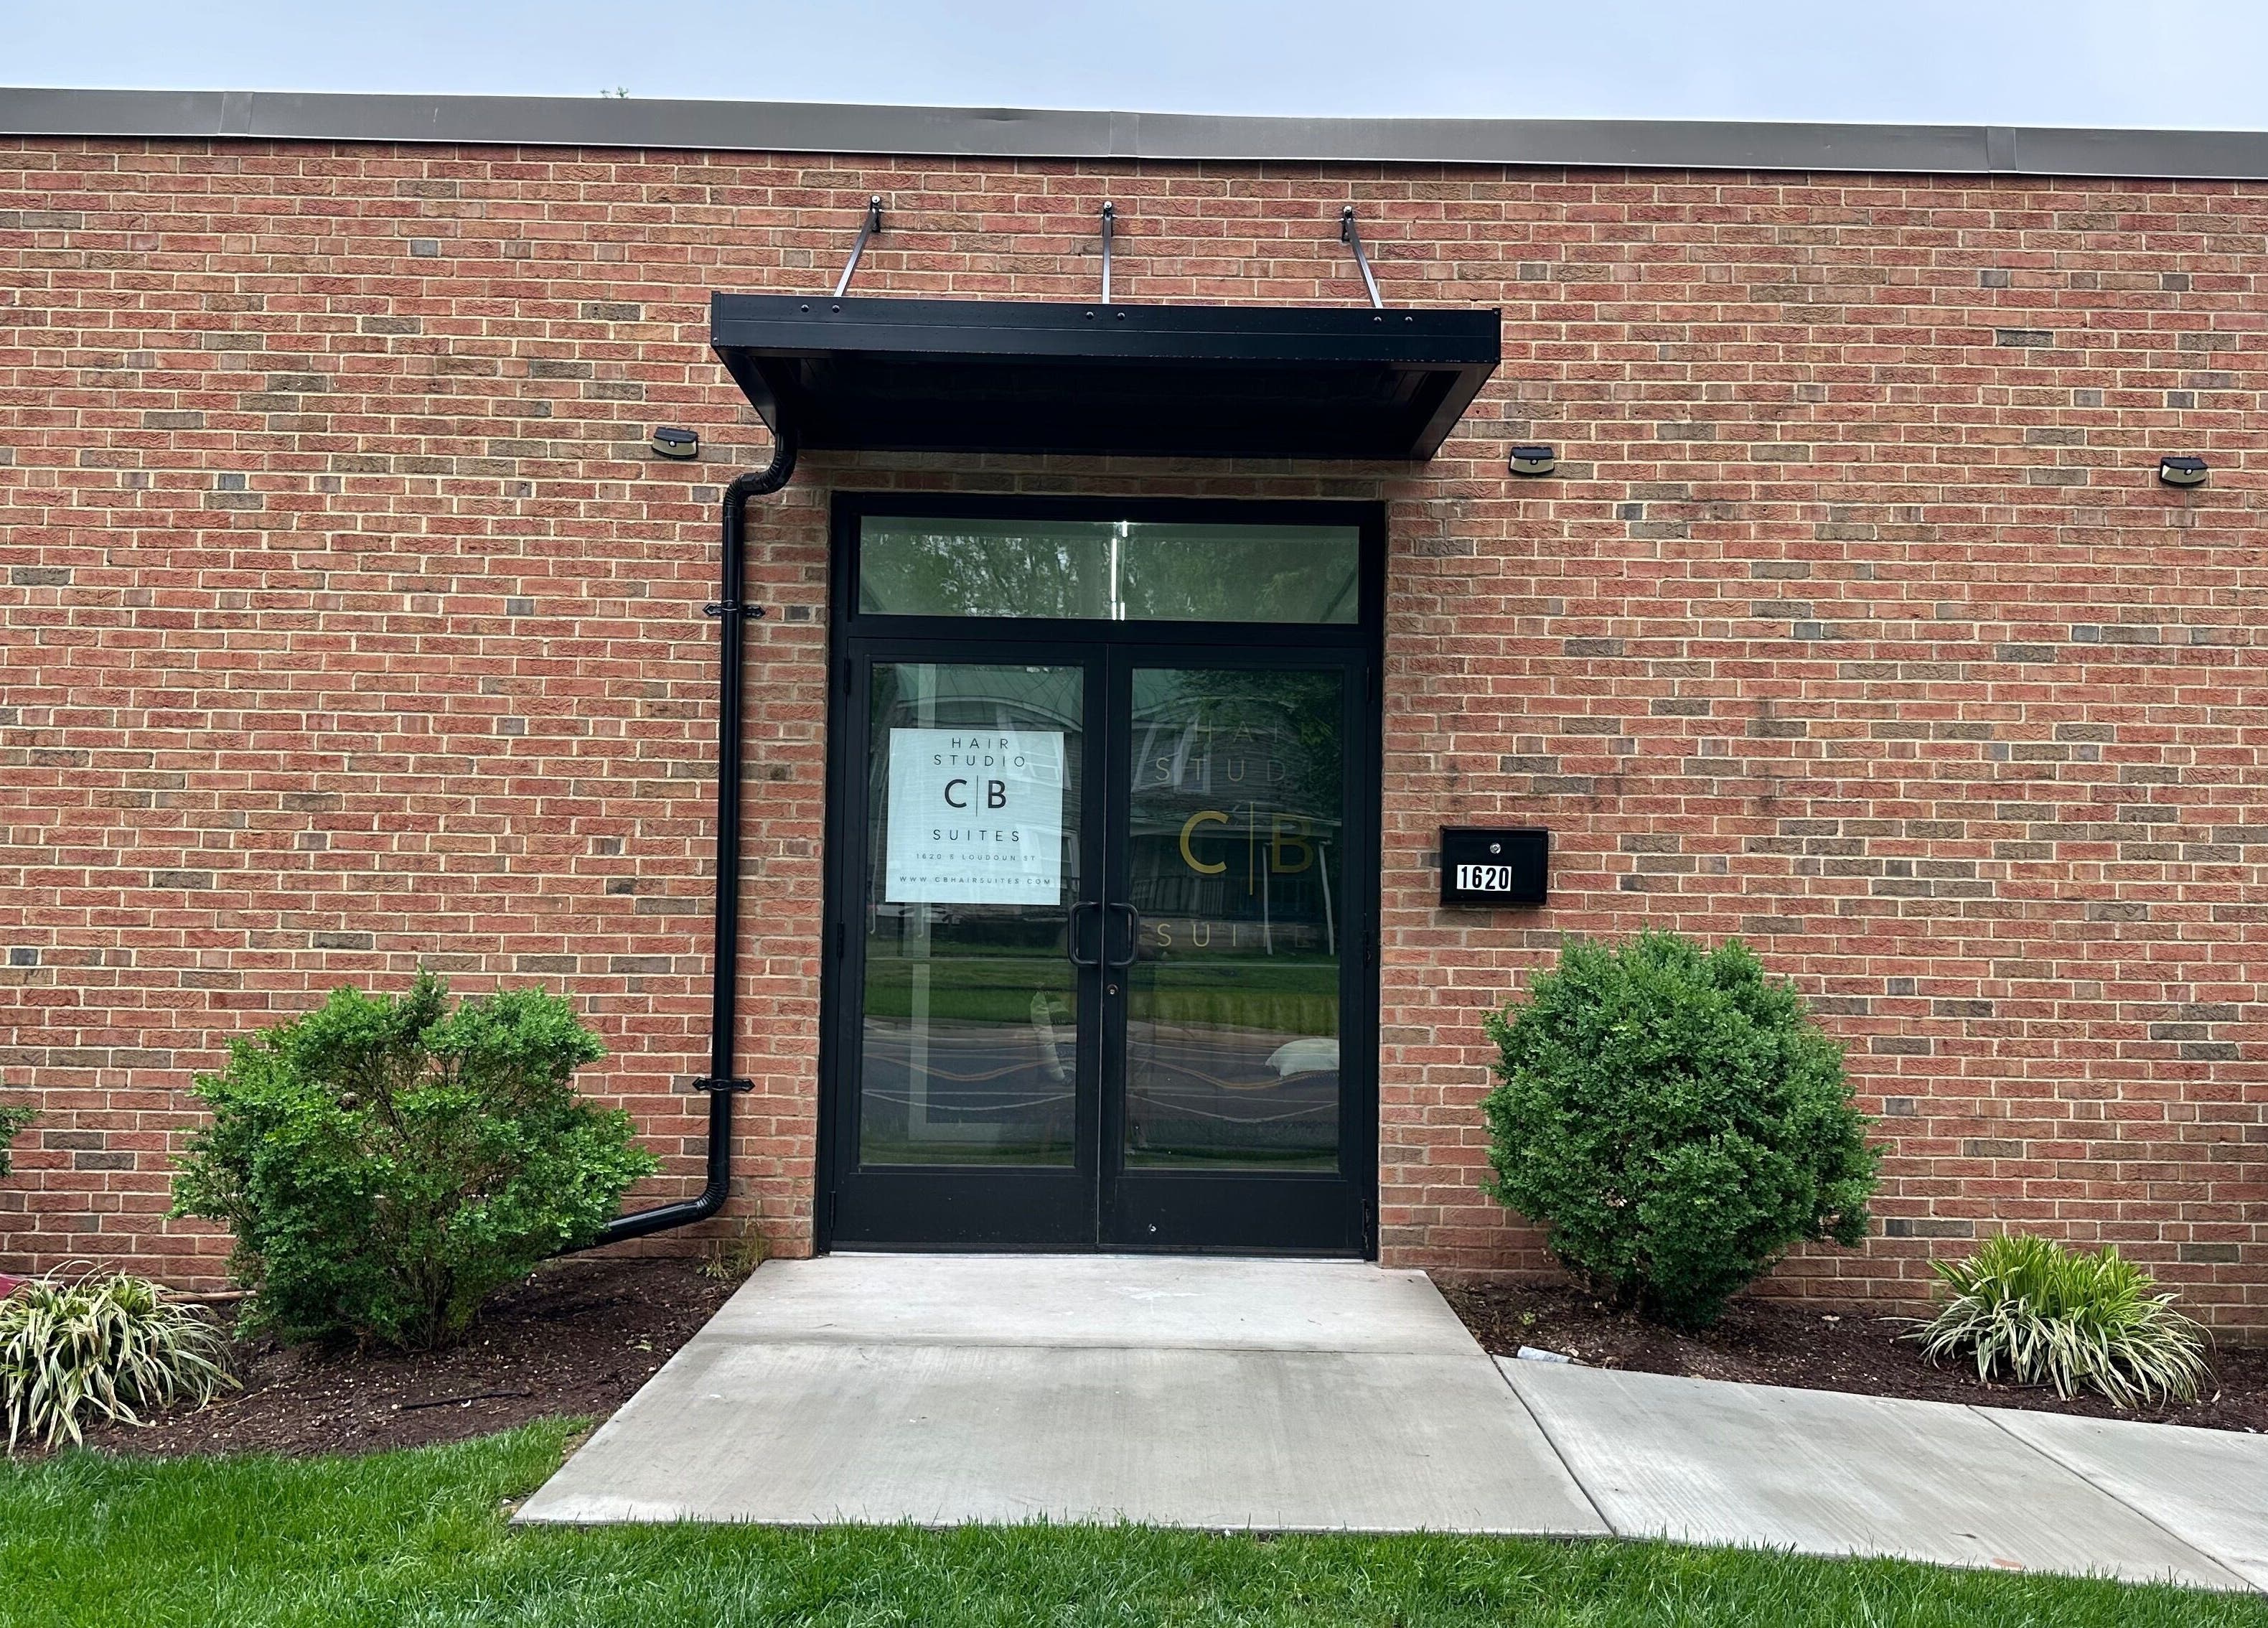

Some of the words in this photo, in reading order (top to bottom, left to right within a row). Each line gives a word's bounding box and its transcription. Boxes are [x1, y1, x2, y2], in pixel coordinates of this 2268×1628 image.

[952, 737, 1008, 749] HAIR
[933, 754, 1025, 767] STUDIO
[933, 829, 1020, 842] SUITES
[1461, 866, 1509, 890] 1620
[1156, 922, 1311, 948] SUITE
